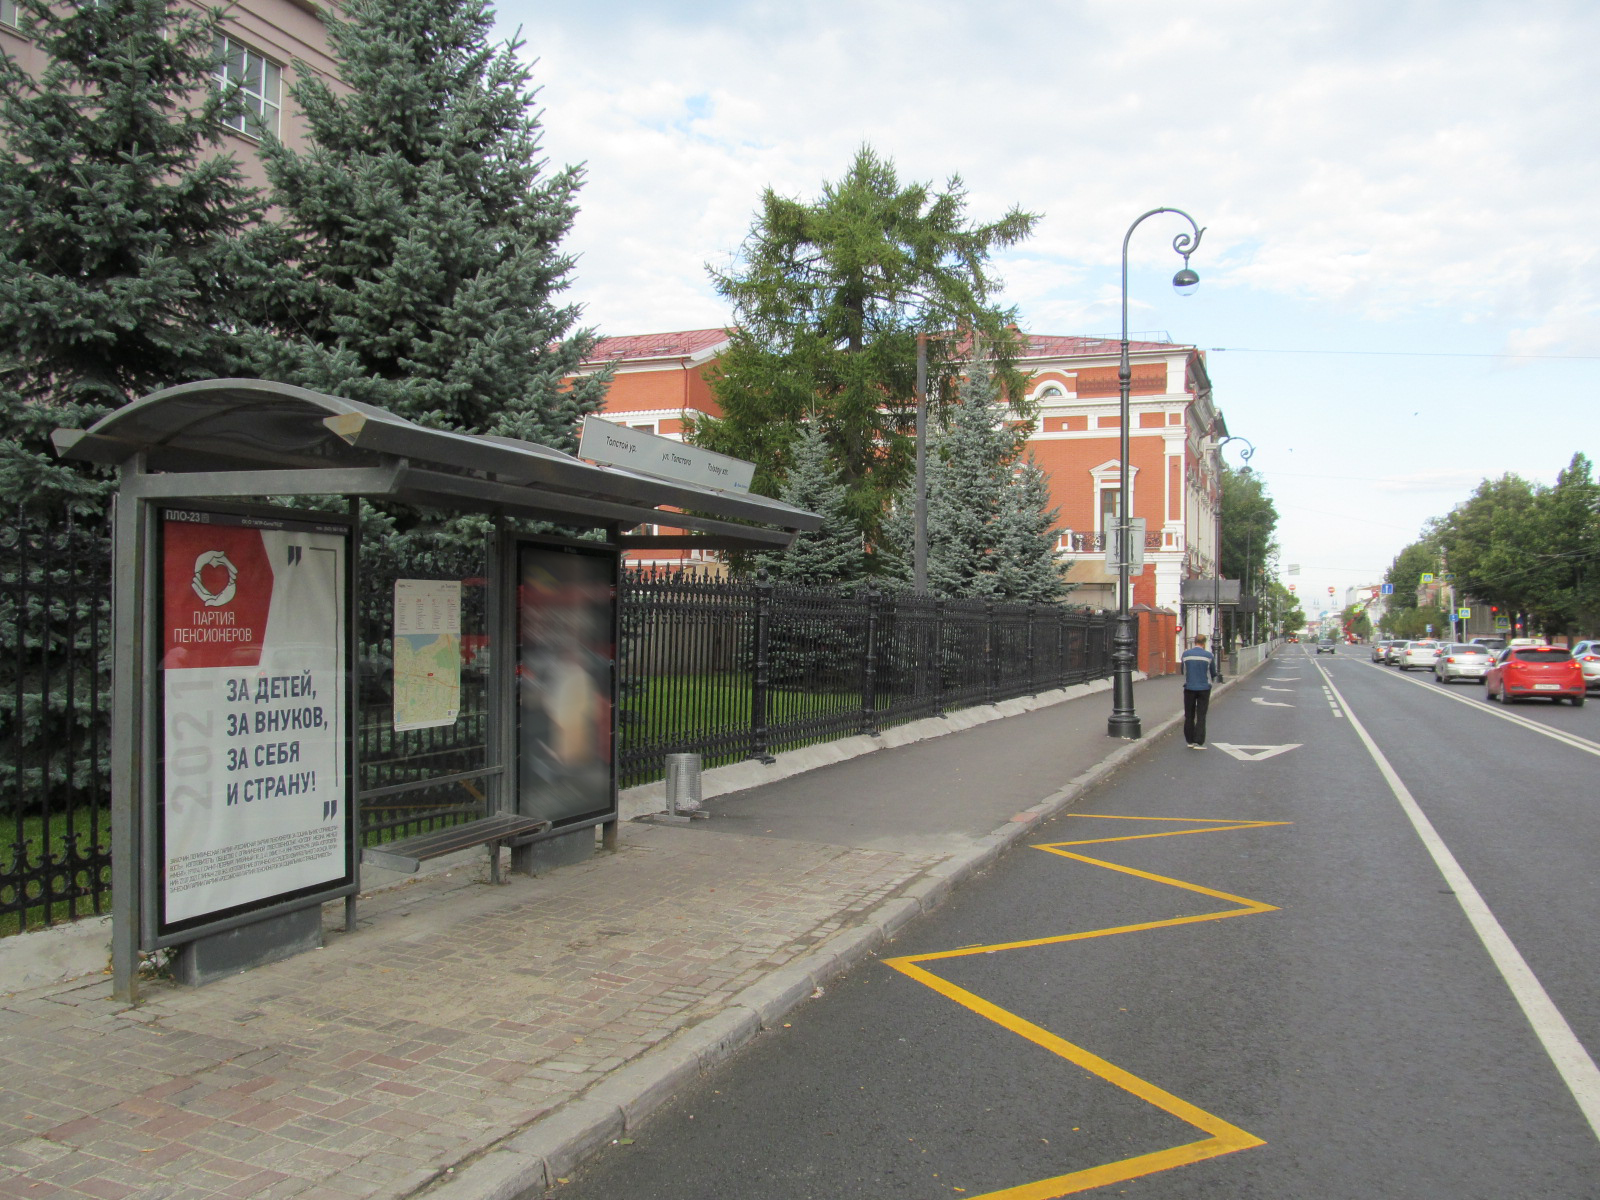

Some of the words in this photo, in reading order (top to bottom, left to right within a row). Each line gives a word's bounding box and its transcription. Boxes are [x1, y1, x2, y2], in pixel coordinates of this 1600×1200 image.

[606, 436, 629, 450] Толстой
[671, 453, 692, 467] Толстого
[165, 509, 200, 523] ПЛО-23
[193, 611, 235, 625] ПАРТИЯ
[174, 628, 252, 643] ПЕНСИОНЕРОВ
[226, 679, 250, 702] ЗА
[255, 669, 317, 704] ДЕТЕЙ,
[226, 713, 250, 736] ЗА
[255, 706, 328, 734] ВНУКОВ,
[171, 680, 214, 815] 2021
[226, 747, 249, 771] ЗА
[254, 741, 300, 767] СЕБЯ
[226, 782, 239, 806] И
[244, 771, 316, 802] СТРАНУ!
